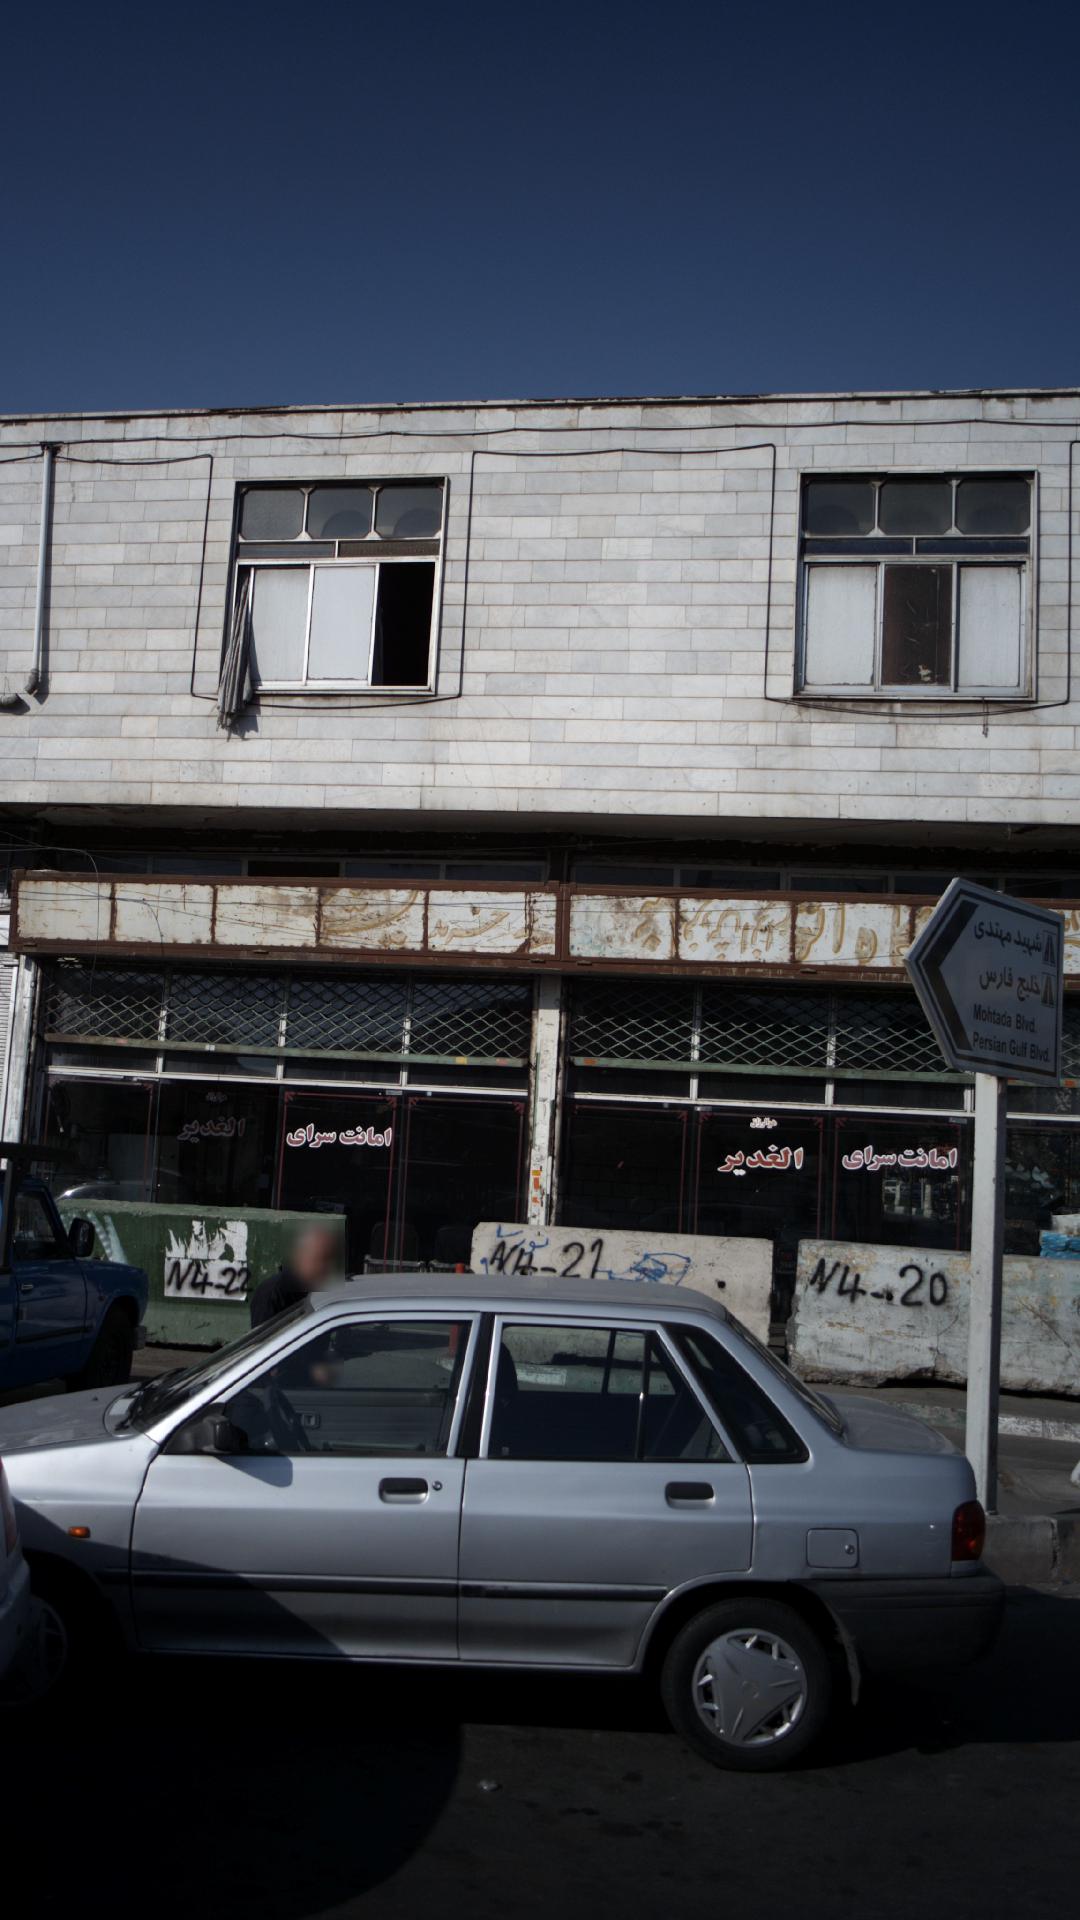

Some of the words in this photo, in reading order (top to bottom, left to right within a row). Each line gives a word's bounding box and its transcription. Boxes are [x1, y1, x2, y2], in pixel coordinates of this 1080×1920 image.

[979, 967, 1013, 990] فارس
[973, 1004, 1012, 1027] Mohtada
[973, 1032, 1006, 1053] Persian
[1009, 1039, 1027, 1057] Gulf
[286, 1122, 337, 1148] سرای
[339, 1125, 393, 1147] امانت
[717, 1144, 805, 1176] الغدیر
[841, 1145, 897, 1171] سرای
[897, 1147, 958, 1169] امانت
[167, 1260, 254, 1296] N4-22
